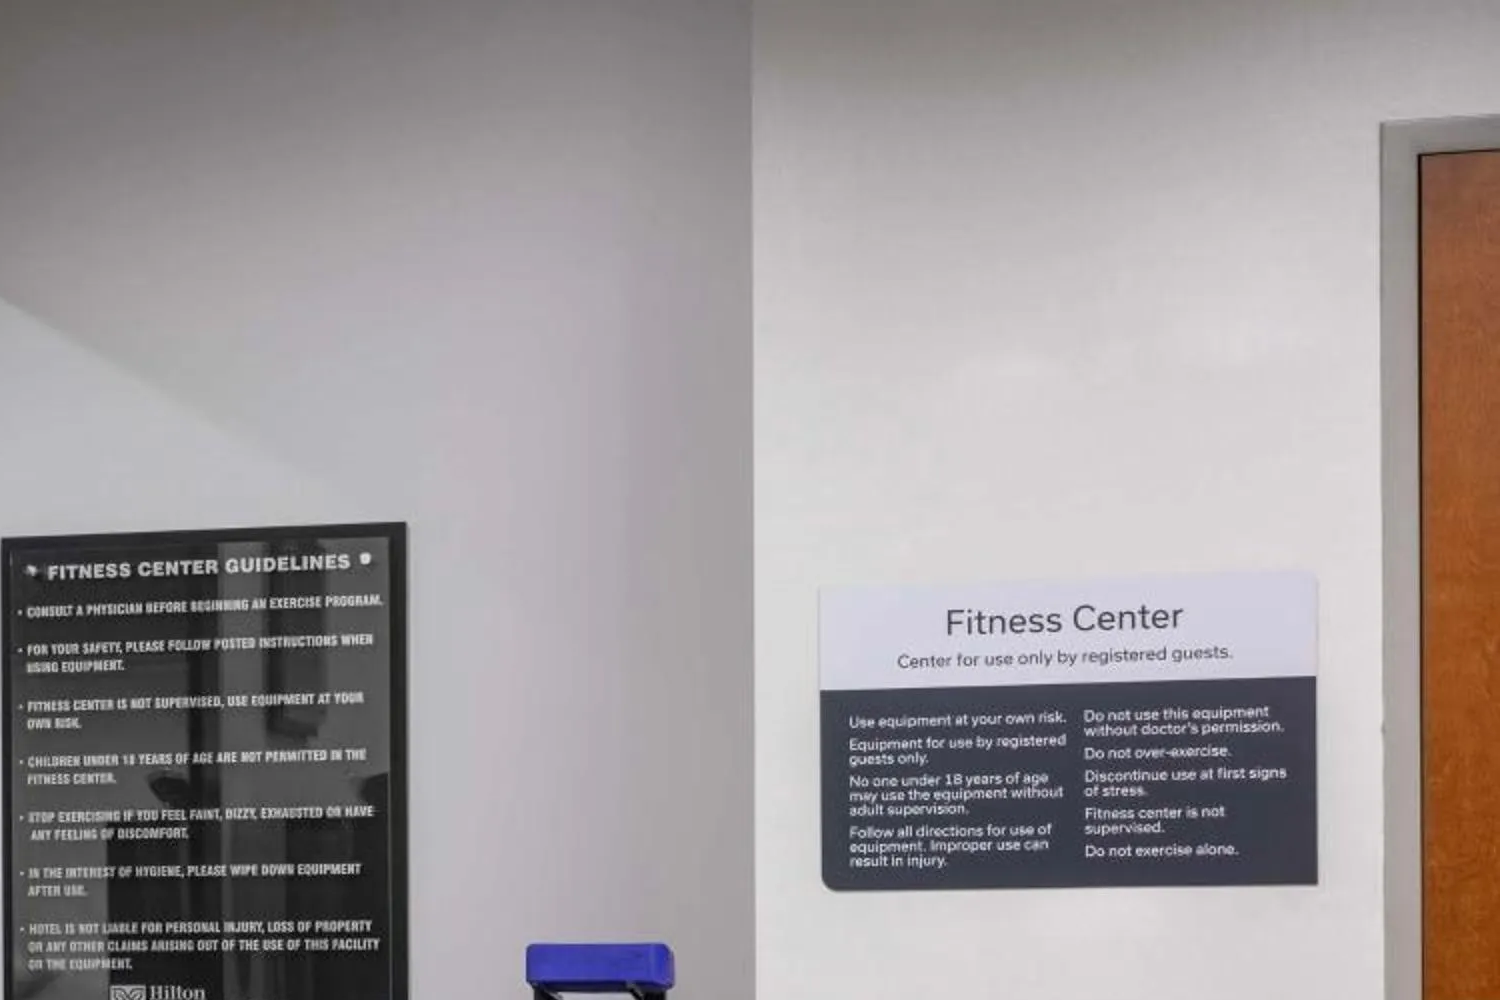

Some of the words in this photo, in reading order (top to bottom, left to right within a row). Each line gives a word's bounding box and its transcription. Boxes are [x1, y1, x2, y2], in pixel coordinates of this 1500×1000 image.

[48, 563, 132, 580] FITNESS
[138, 560, 218, 576] CENTER
[225, 554, 351, 573] GUIDELINES
[947, 609, 1062, 635] Fitness
[1074, 604, 1183, 631] Center
[898, 654, 951, 669] Center
[957, 653, 979, 667] for
[985, 654, 1013, 666] use
[1018, 650, 1053, 667] only
[1058, 649, 1077, 666] by
[1082, 647, 1166, 665] registered
[1083, 710, 1104, 722] Do
[1108, 710, 1130, 721] not
[1135, 710, 1159, 720] use
[1163, 707, 1188, 719] this
[1192, 706, 1269, 720] equipment
[850, 716, 875, 728] Use
[878, 715, 951, 729] equipment
[956, 714, 968, 726] at
[972, 715, 1002, 728] your
[1006, 714, 1034, 724] own
[1084, 724, 1137, 736] without
[1141, 722, 1198, 735] doctor's
[850, 738, 922, 751] Equipment
[927, 737, 945, 749] for
[950, 738, 973, 748] use
[976, 736, 992, 750] by
[997, 734, 1067, 748] registered
[850, 754, 894, 767] guests
[1084, 748, 1104, 760] Do
[1108, 747, 1131, 759] not
[850, 776, 868, 787] No
[873, 777, 897, 786] one
[902, 774, 941, 787] under
[946, 773, 962, 785] 18
[965, 774, 1002, 789] years
[1006, 772, 1020, 785] of
[1023, 773, 1048, 788] age
[1085, 770, 1168, 783] Discontinue
[1172, 770, 1196, 781] use
[1200, 769, 1213, 780] at
[1217, 767, 1245, 779] first
[1249, 768, 1287, 781] signs
[850, 792, 877, 802] may
[881, 790, 905, 801] use
[909, 788, 930, 800] the
[934, 788, 1007, 803] equipment
[1012, 786, 1063, 798] without
[1084, 786, 1098, 796] of
[850, 805, 883, 816] adult
[1085, 808, 1135, 820] Fitness
[1138, 807, 1182, 819] center
[1186, 806, 1198, 818] is
[1202, 806, 1225, 817] not
[850, 826, 894, 838] Follow
[898, 825, 912, 837] all
[916, 824, 983, 837] directions
[987, 824, 1006, 836] for
[1010, 825, 1034, 835] use
[1038, 824, 1052, 835] of
[931, 840, 992, 854] Improper
[997, 840, 1020, 850] use
[1024, 840, 1048, 850] can
[1085, 845, 1104, 857] Do
[1109, 845, 1132, 856] not
[1136, 843, 1192, 856] exercise
[850, 856, 888, 867] result
[892, 856, 903, 866] in
[150, 986, 205, 1000] Hilton
